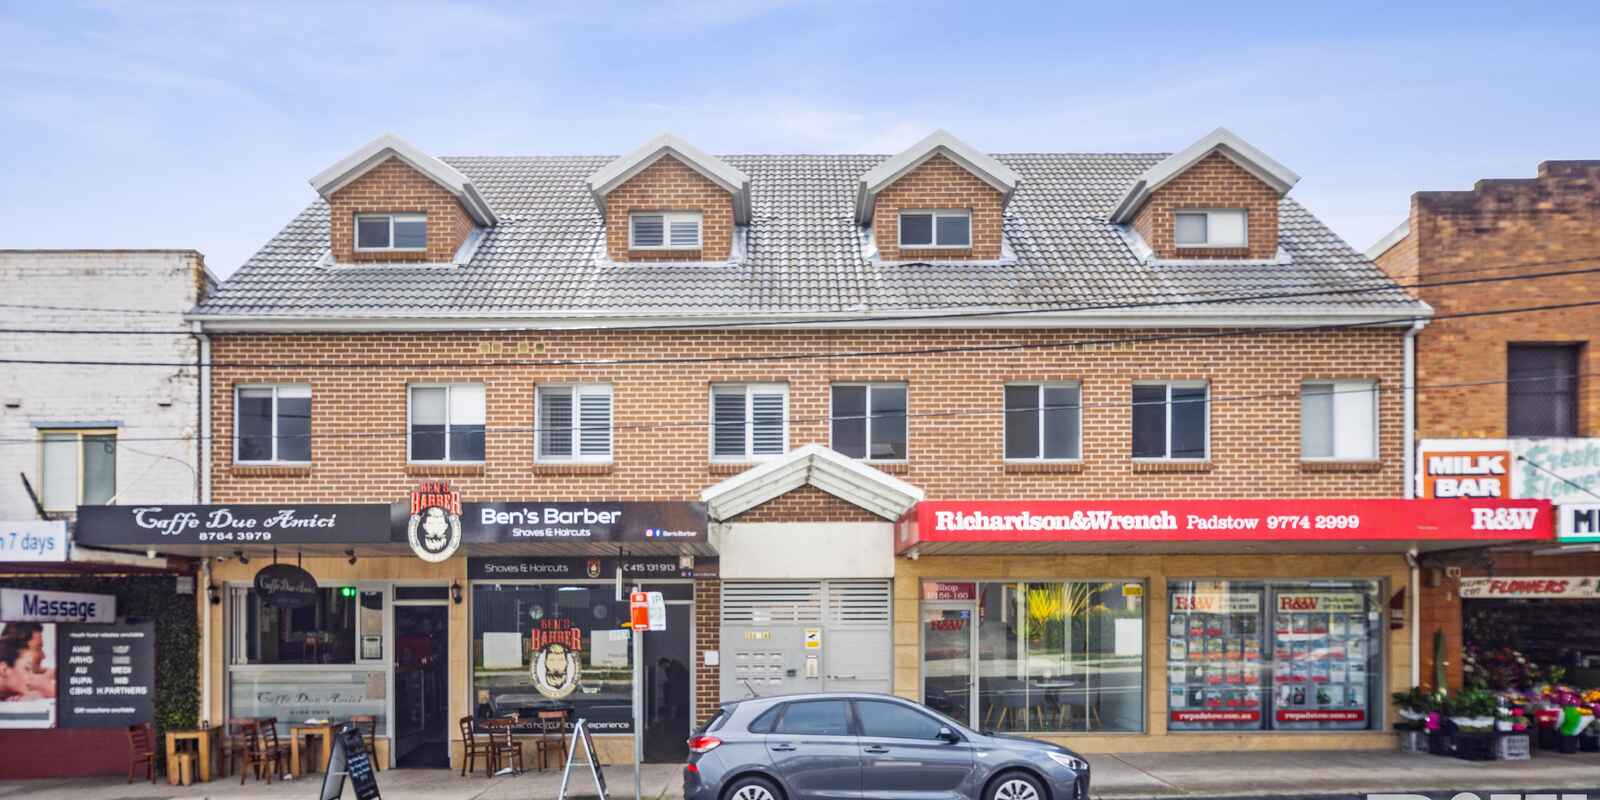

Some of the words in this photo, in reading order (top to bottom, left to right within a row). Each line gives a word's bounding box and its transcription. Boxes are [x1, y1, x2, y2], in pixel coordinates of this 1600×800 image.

[1429, 456, 1505, 475] MILK
[1435, 478, 1501, 498] BAR
[411, 491, 461, 515] BARBER
[132, 507, 199, 535] Caffe
[205, 508, 257, 529] Due
[263, 509, 337, 528] Amici
[481, 508, 539, 525] Ben's
[544, 508, 622, 525] Barber
[935, 510, 1178, 531] Richardson&Wrench
[1187, 515, 1259, 530] Padstow
[1266, 515, 1310, 530] 9774
[1315, 515, 1360, 530] 2999
[1471, 507, 1539, 530] R&W
[199, 532, 233, 541] 8764
[237, 532, 272, 541] 3979
[512, 528, 544, 537] Shaves
[545, 528, 553, 537] &
[554, 528, 591, 537] Haircuts
[9, 533, 17, 550] 7
[21, 532, 54, 555] days
[484, 563, 518, 573] Shaves
[520, 563, 528, 573] &
[529, 563, 568, 573] Haircuts
[1487, 580, 1569, 594] FLOWERS
[23, 594, 96, 619] Massage
[1280, 597, 1318, 609] R&W
[531, 628, 582, 650] BARBER
